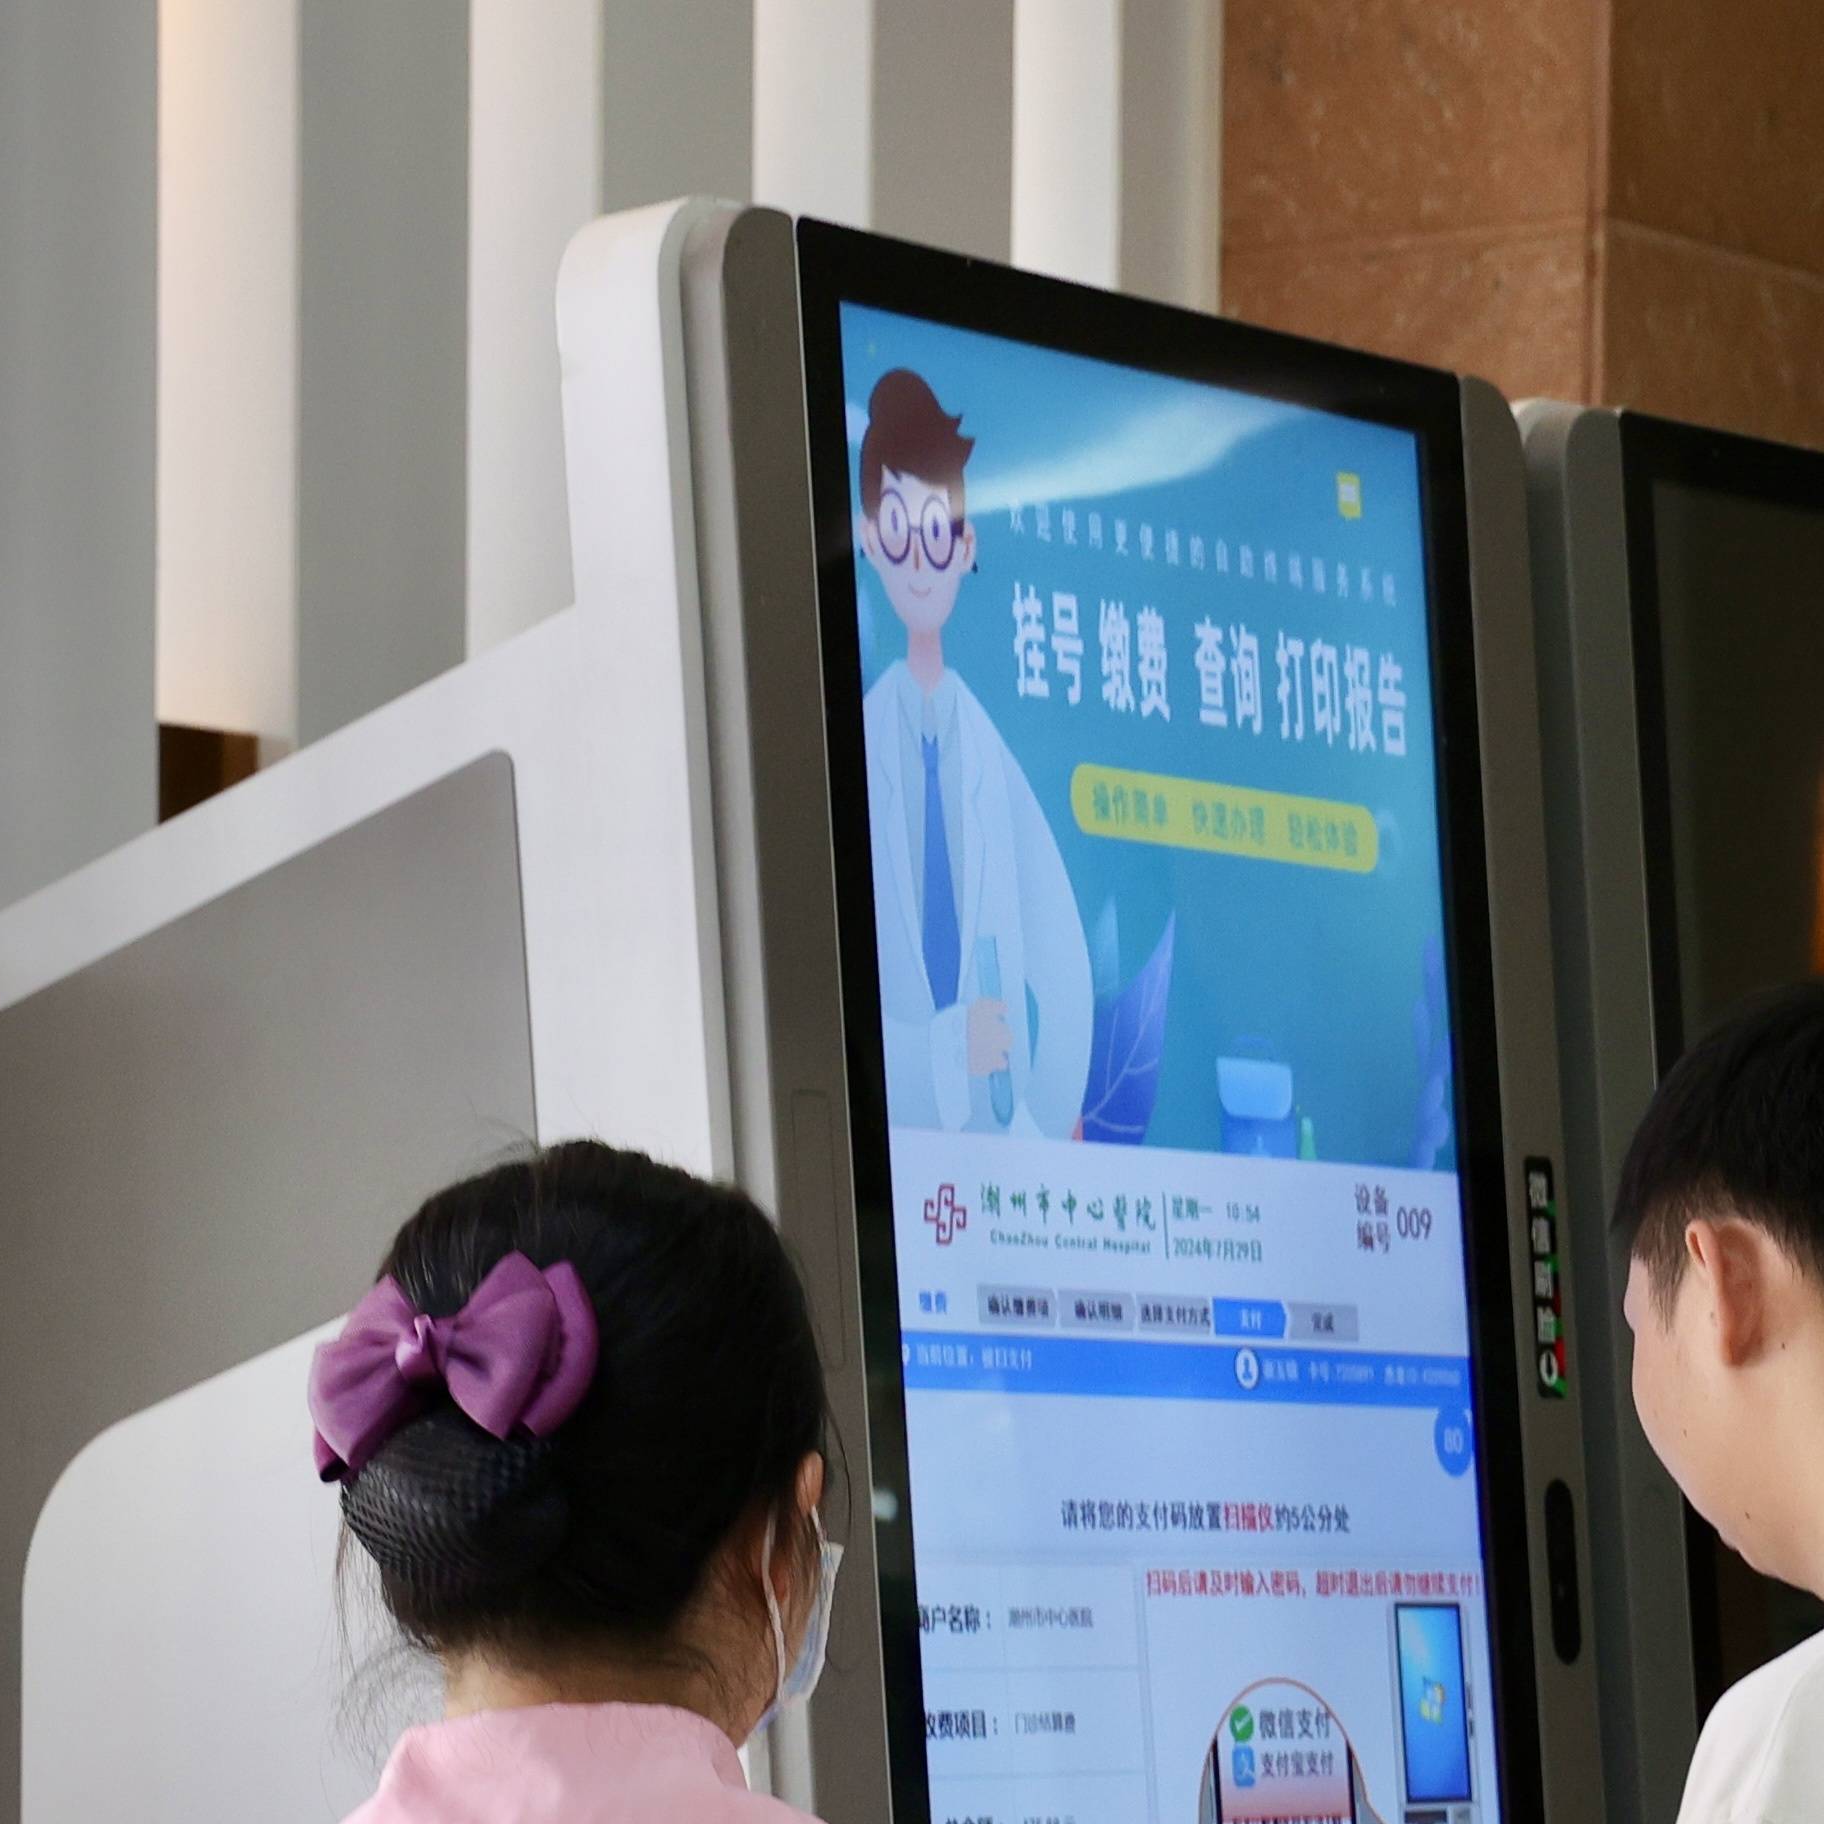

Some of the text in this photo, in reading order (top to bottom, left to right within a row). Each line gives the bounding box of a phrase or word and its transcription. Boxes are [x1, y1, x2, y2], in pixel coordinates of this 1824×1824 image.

[1013, 582, 1406, 756] 挂号 缴费 查询 打印报告
[1397, 1206, 1431, 1240] 009
[1260, 1707, 1330, 1739] 微信支付
